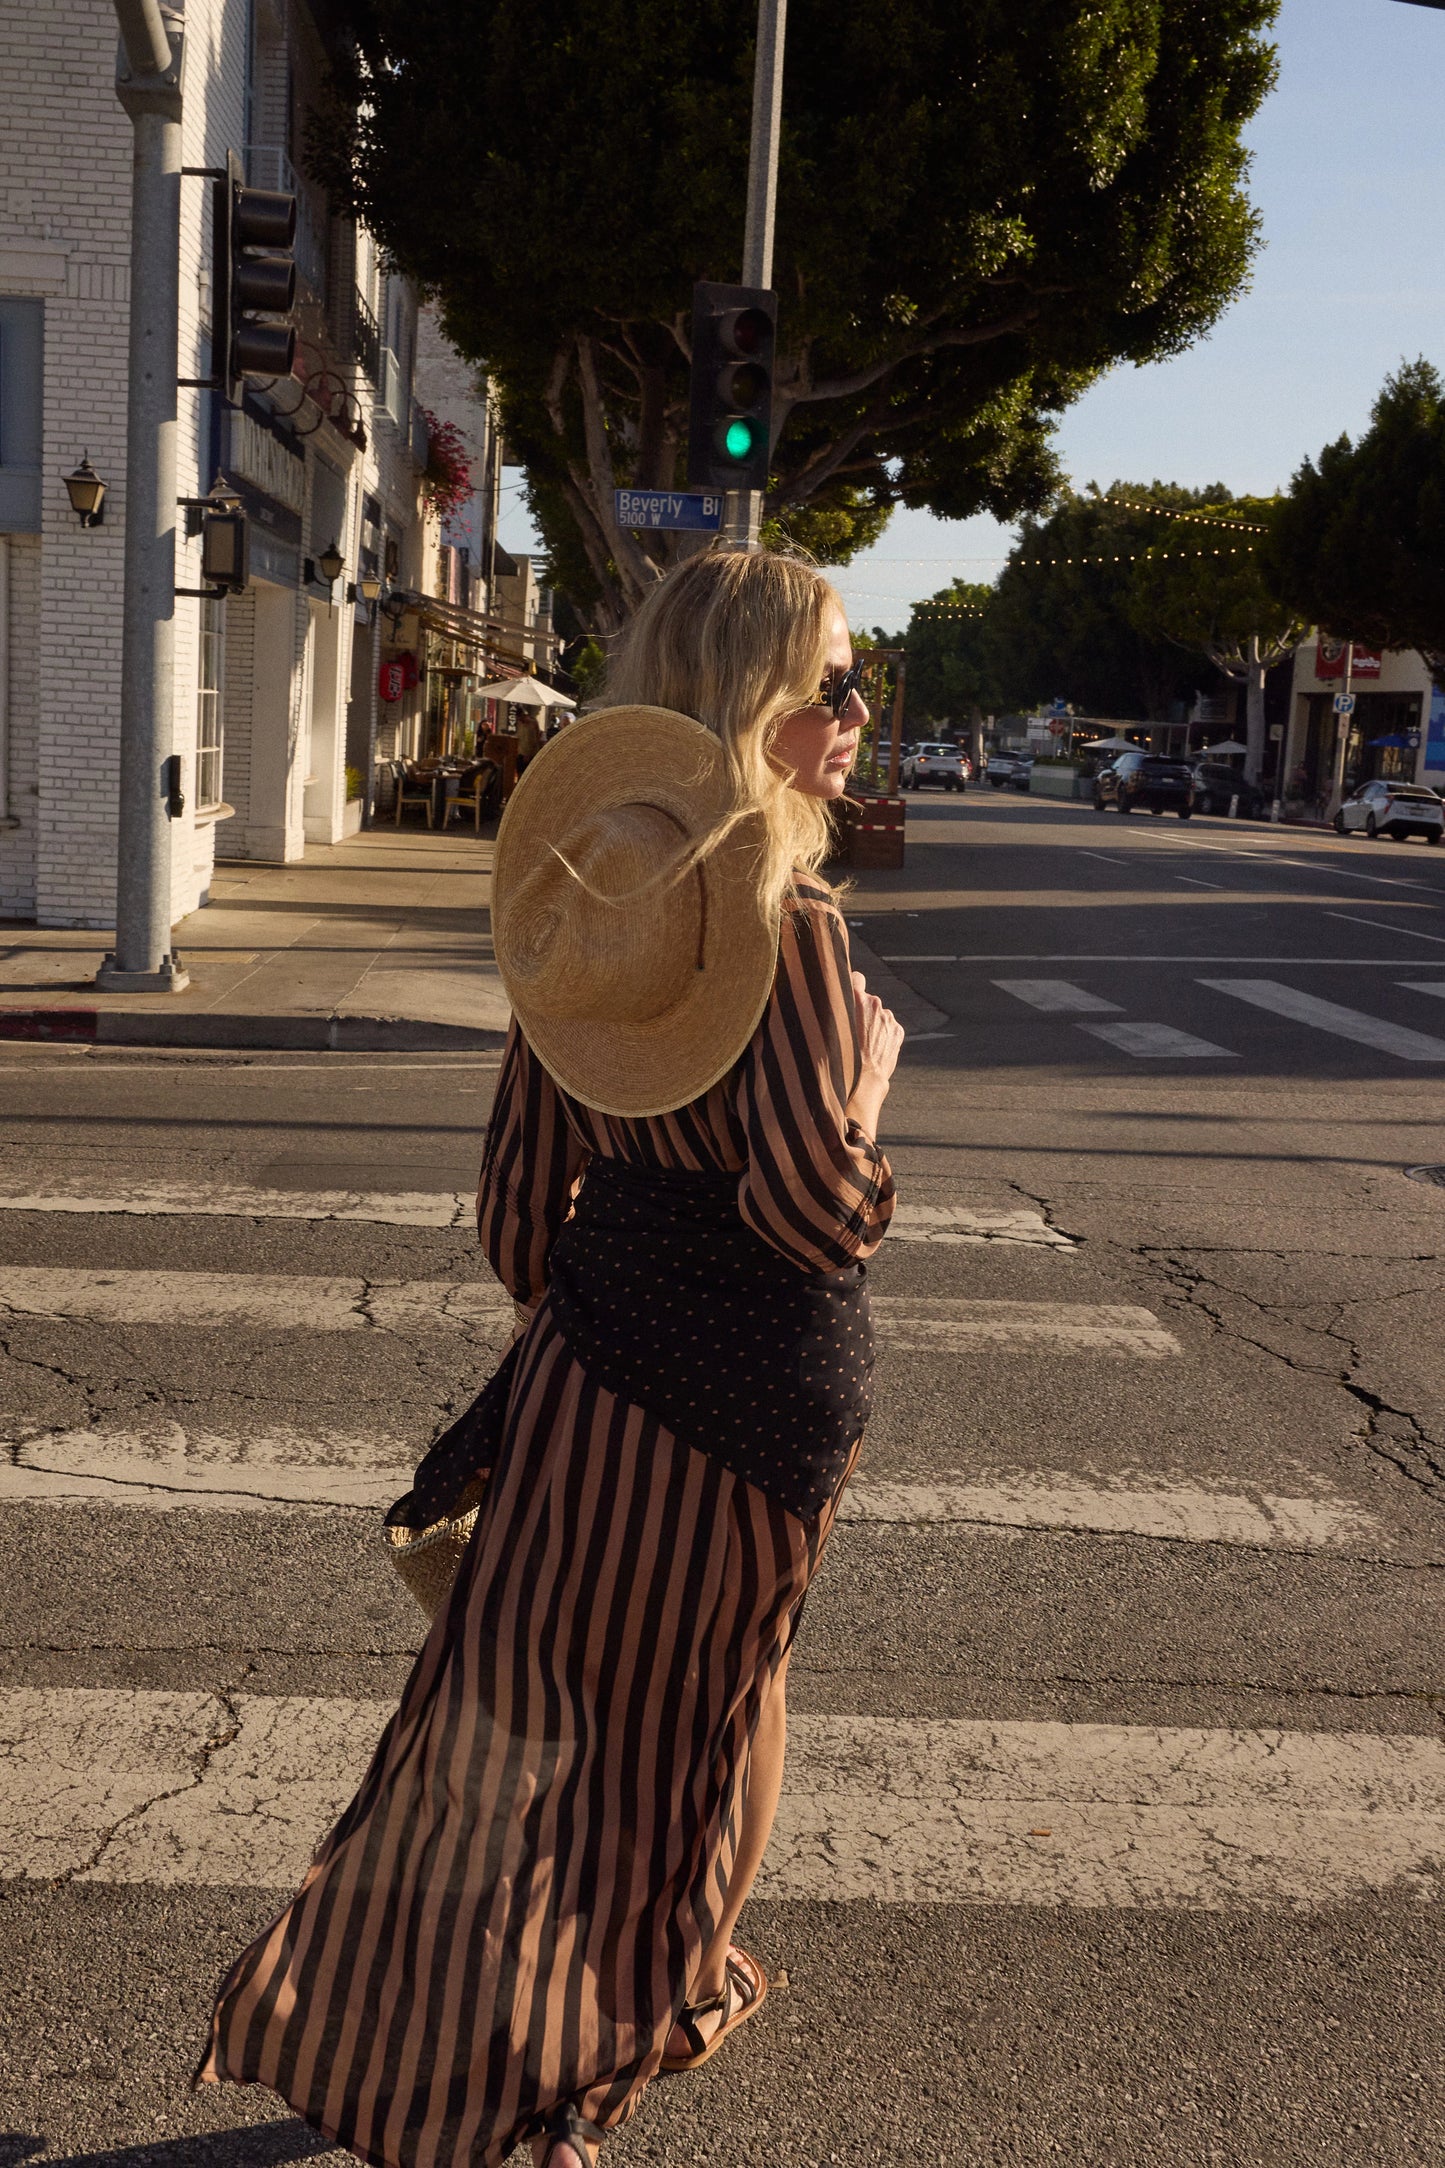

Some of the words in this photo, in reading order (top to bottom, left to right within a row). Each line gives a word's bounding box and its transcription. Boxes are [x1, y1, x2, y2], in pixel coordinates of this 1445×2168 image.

[620, 492, 682, 518] Beverly
[703, 497, 718, 515] Bl
[620, 512, 645, 525] 5100
[651, 513, 660, 525] W
[1339, 696, 1352, 711] P
